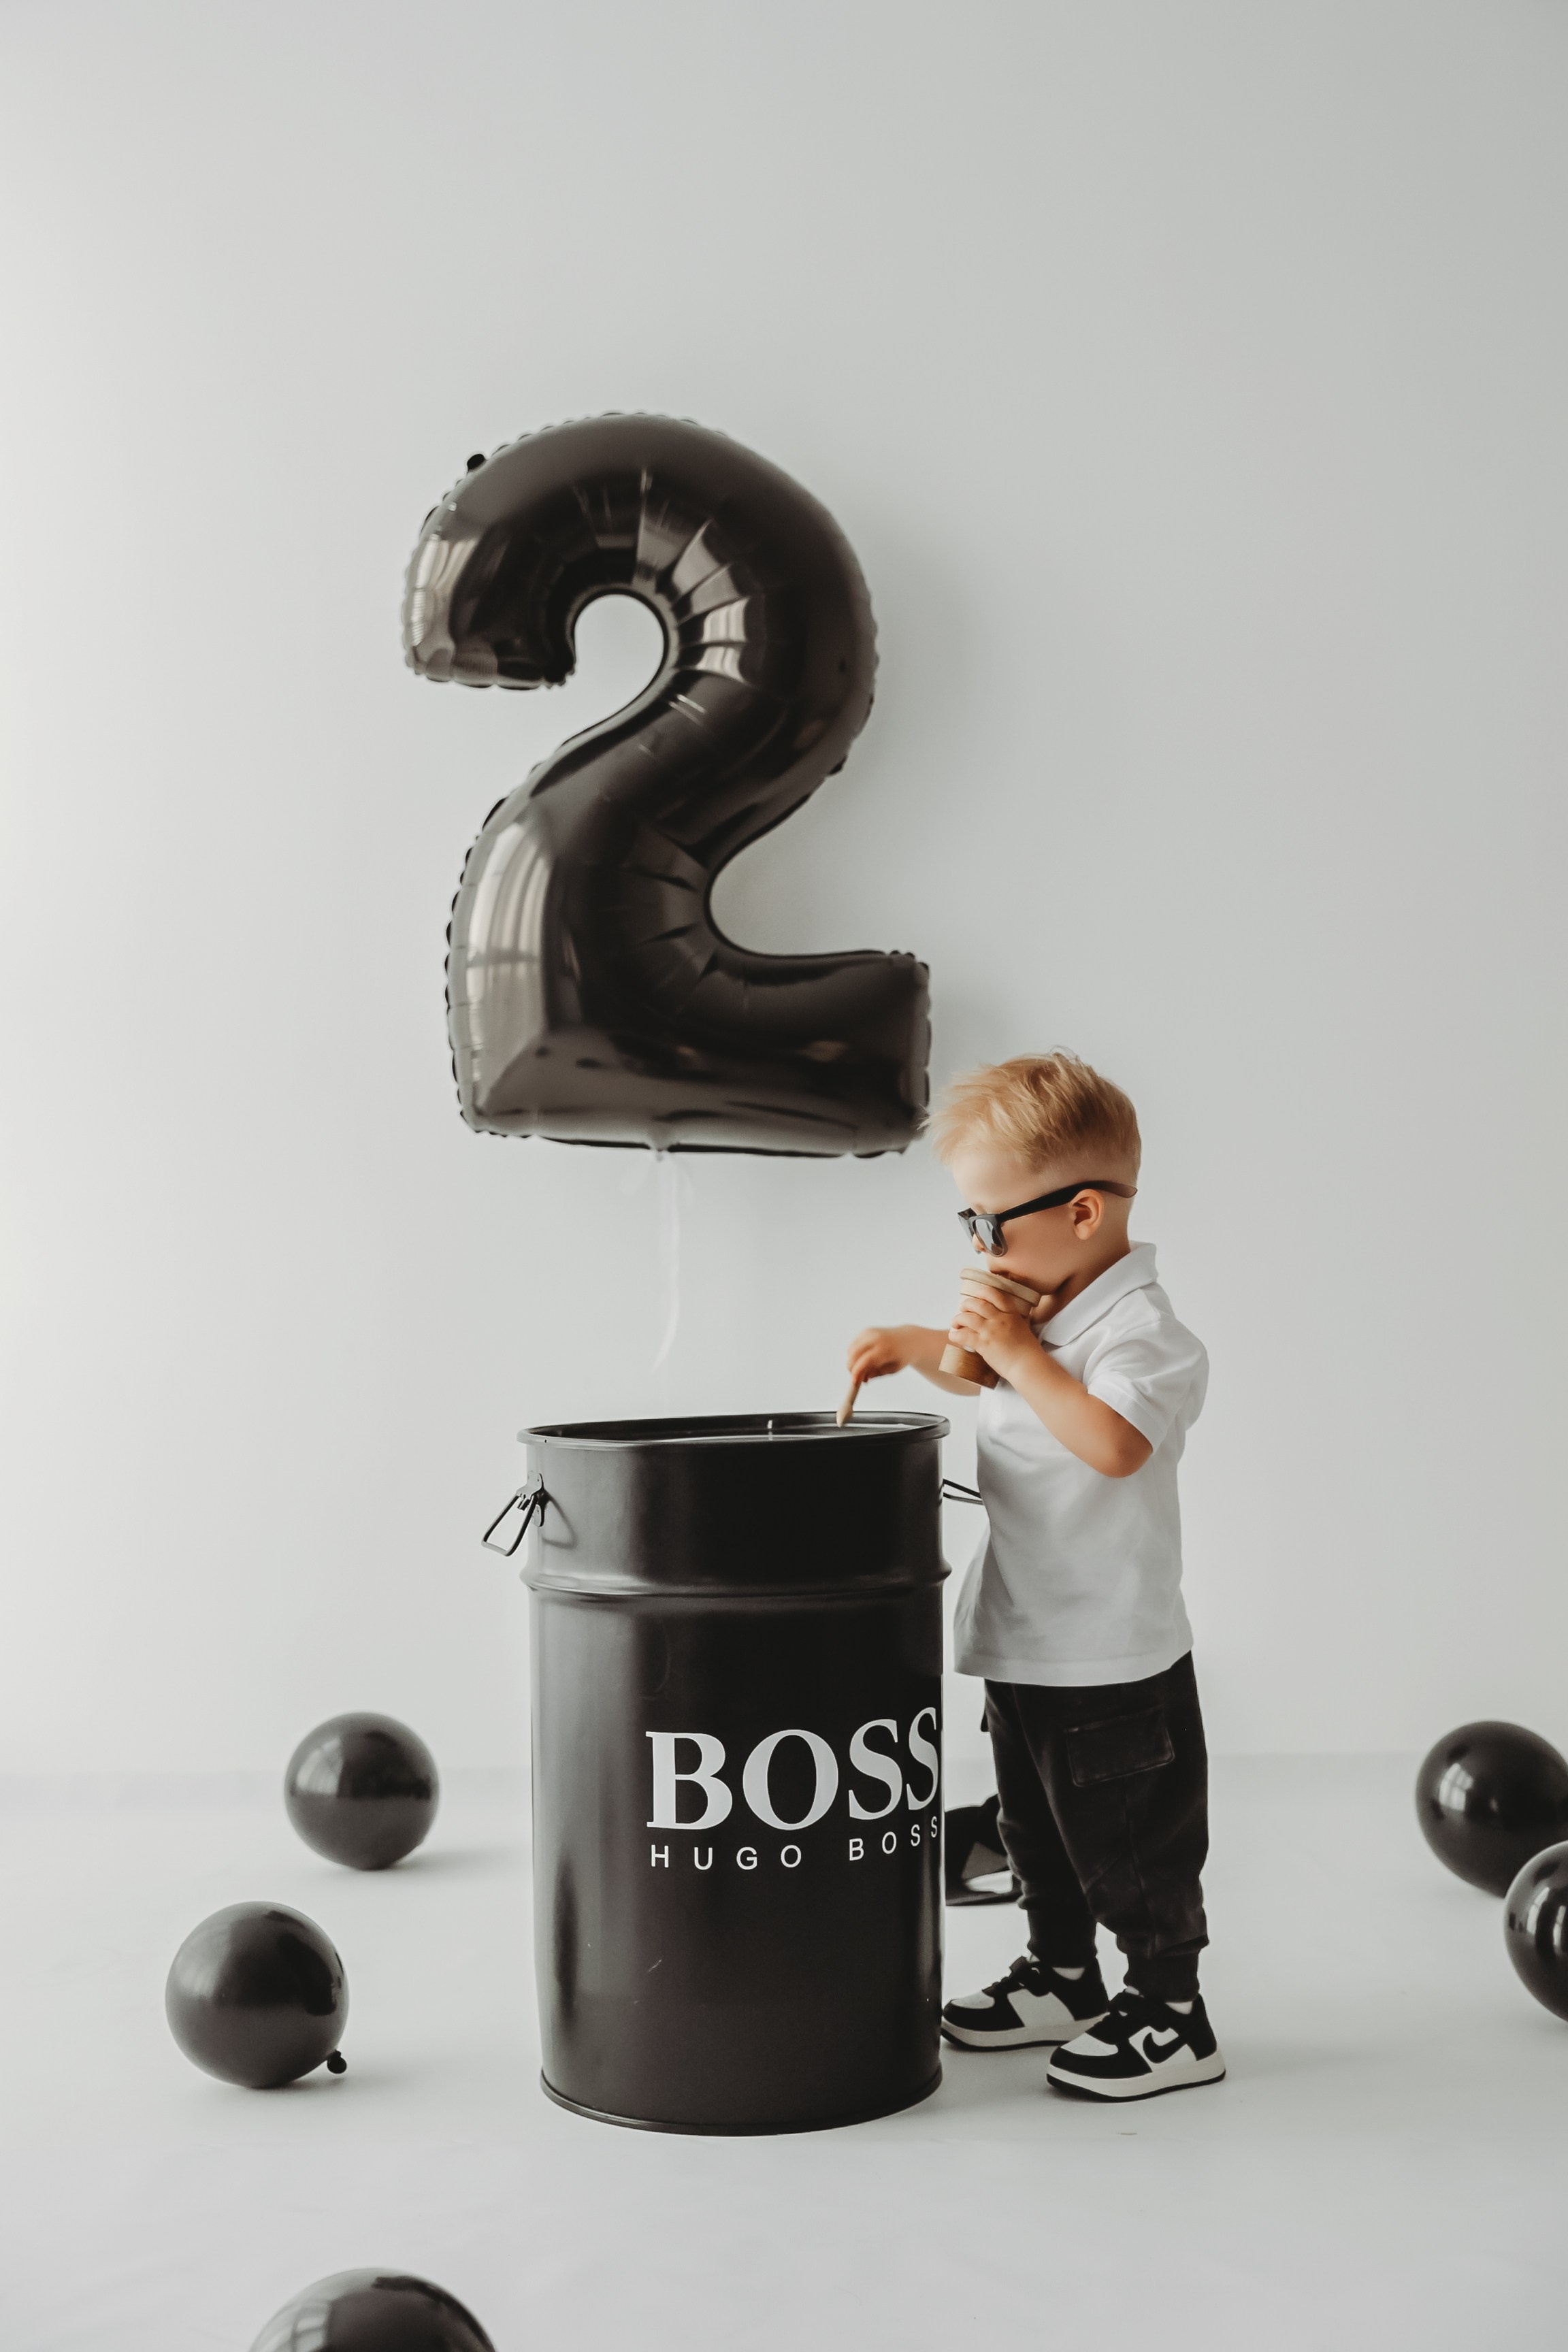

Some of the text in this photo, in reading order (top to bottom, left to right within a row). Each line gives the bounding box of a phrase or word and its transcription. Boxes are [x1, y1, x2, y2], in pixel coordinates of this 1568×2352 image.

[403, 411, 931, 1158] 2
[645, 1707, 938, 1831] BOSS
[651, 1816, 938, 1871] HUGO BOSS
